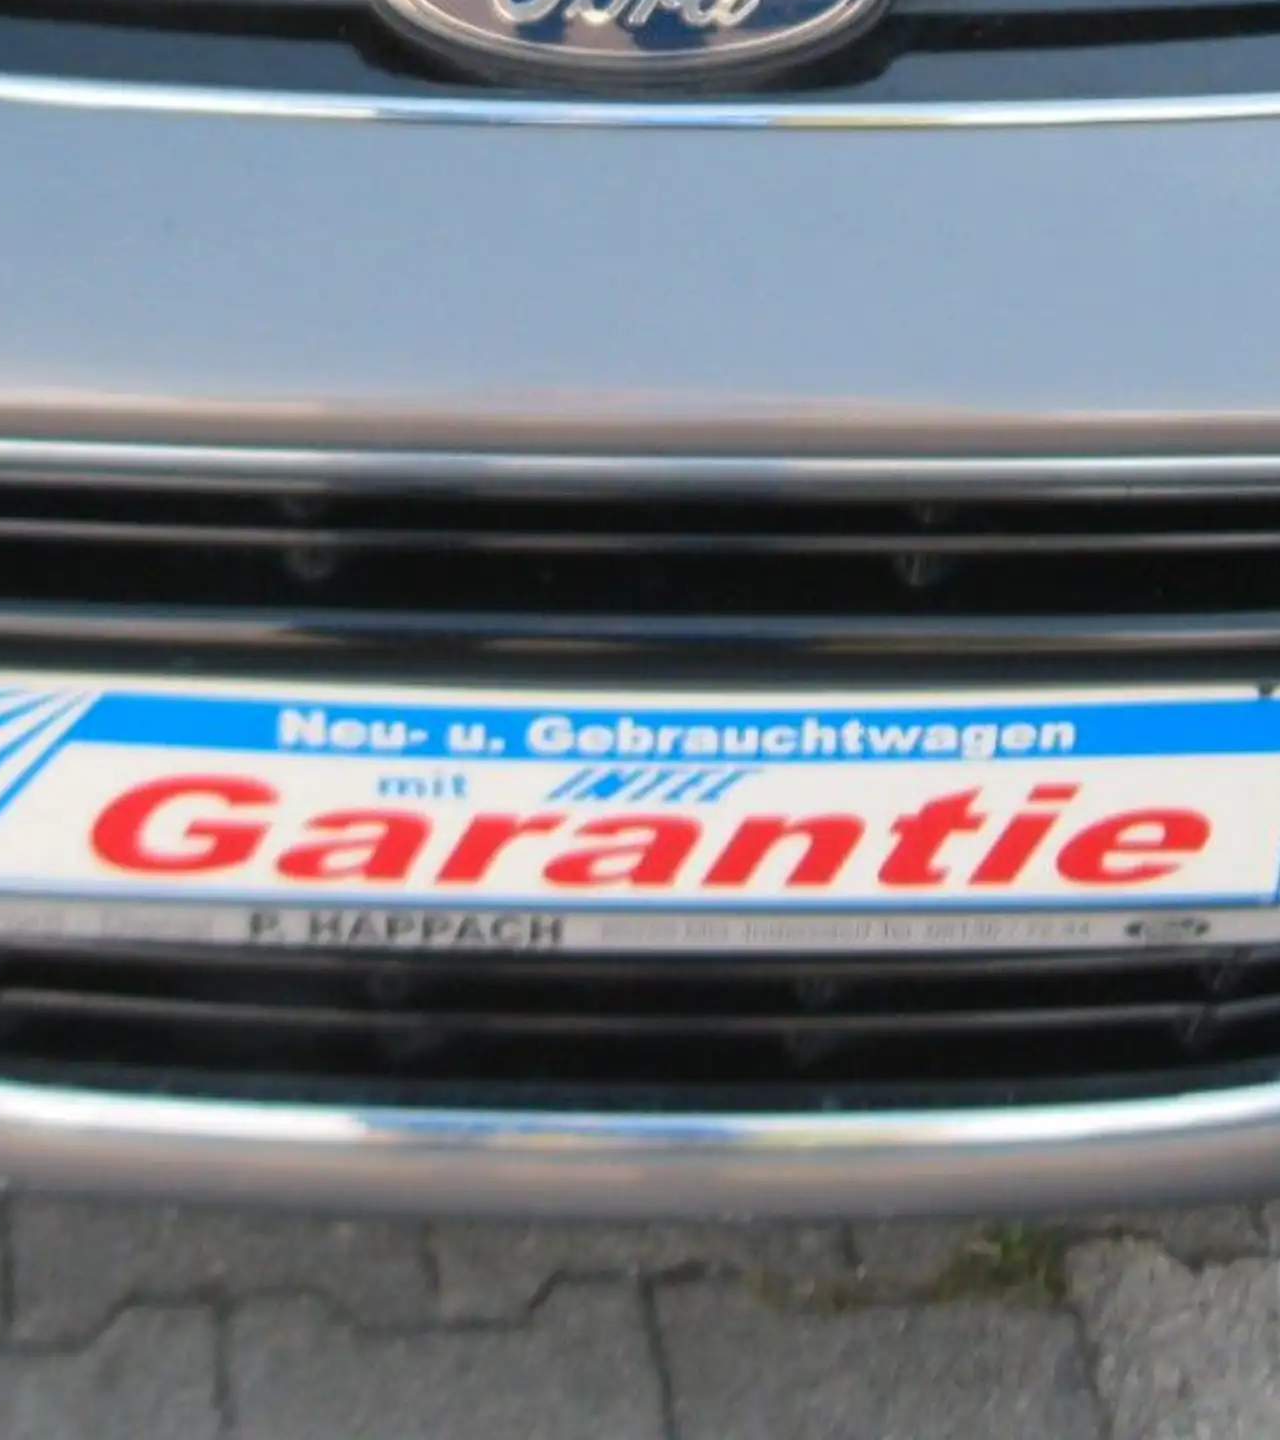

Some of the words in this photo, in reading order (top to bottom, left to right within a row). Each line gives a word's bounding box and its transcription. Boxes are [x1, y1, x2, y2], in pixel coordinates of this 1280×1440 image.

[278, 708, 428, 750] Neu-
[447, 722, 506, 753] u.
[525, 714, 1078, 760] Gebrauchtwagen
[377, 773, 468, 800] mit
[88, 774, 1210, 888] Garantie
